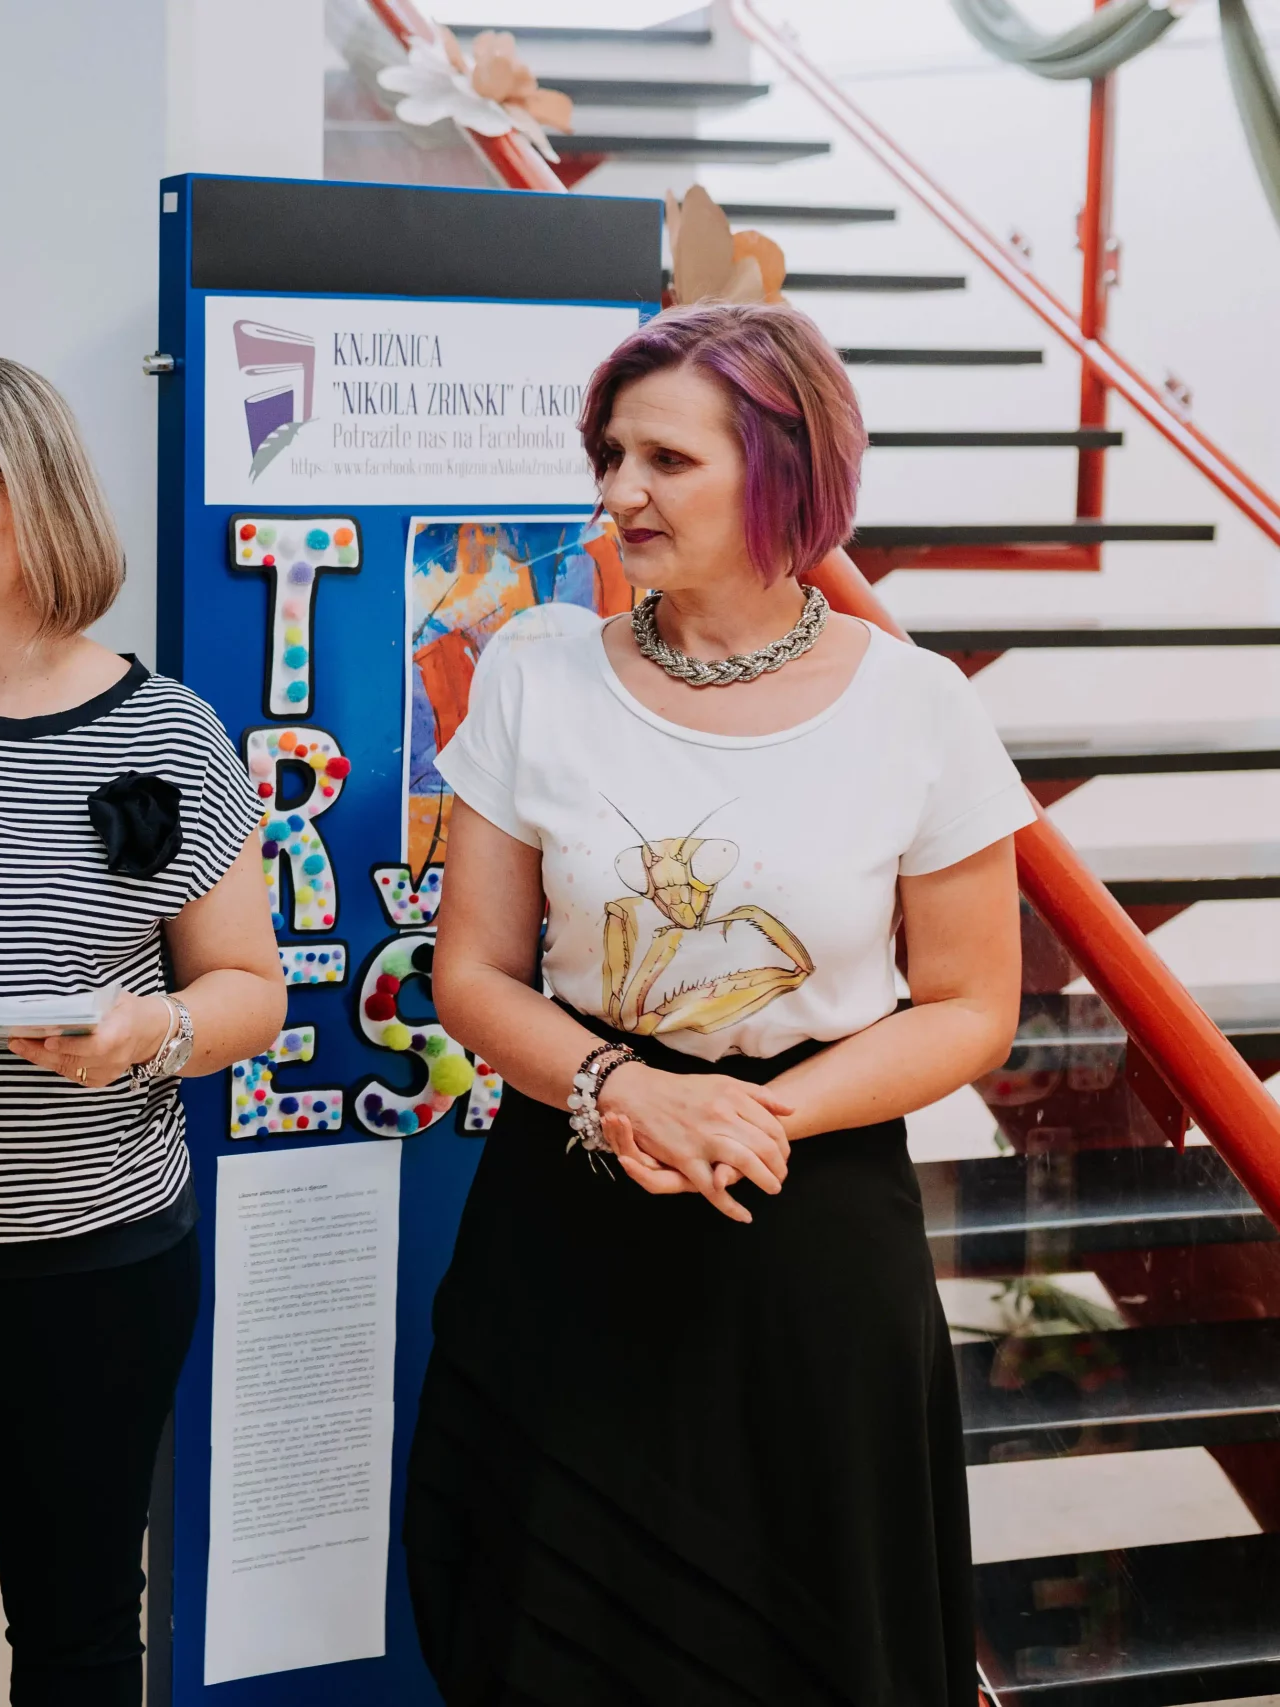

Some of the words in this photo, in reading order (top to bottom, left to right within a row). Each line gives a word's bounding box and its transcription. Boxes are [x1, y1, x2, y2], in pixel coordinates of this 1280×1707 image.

[333, 328, 443, 368] KNJIŽNICA
[332, 381, 418, 415] "NIKOLA
[426, 382, 514, 416] ZRINSKI"
[332, 422, 412, 449] Potražite
[418, 428, 447, 449] nas
[452, 428, 473, 449] na
[478, 423, 566, 449] Facebooku
